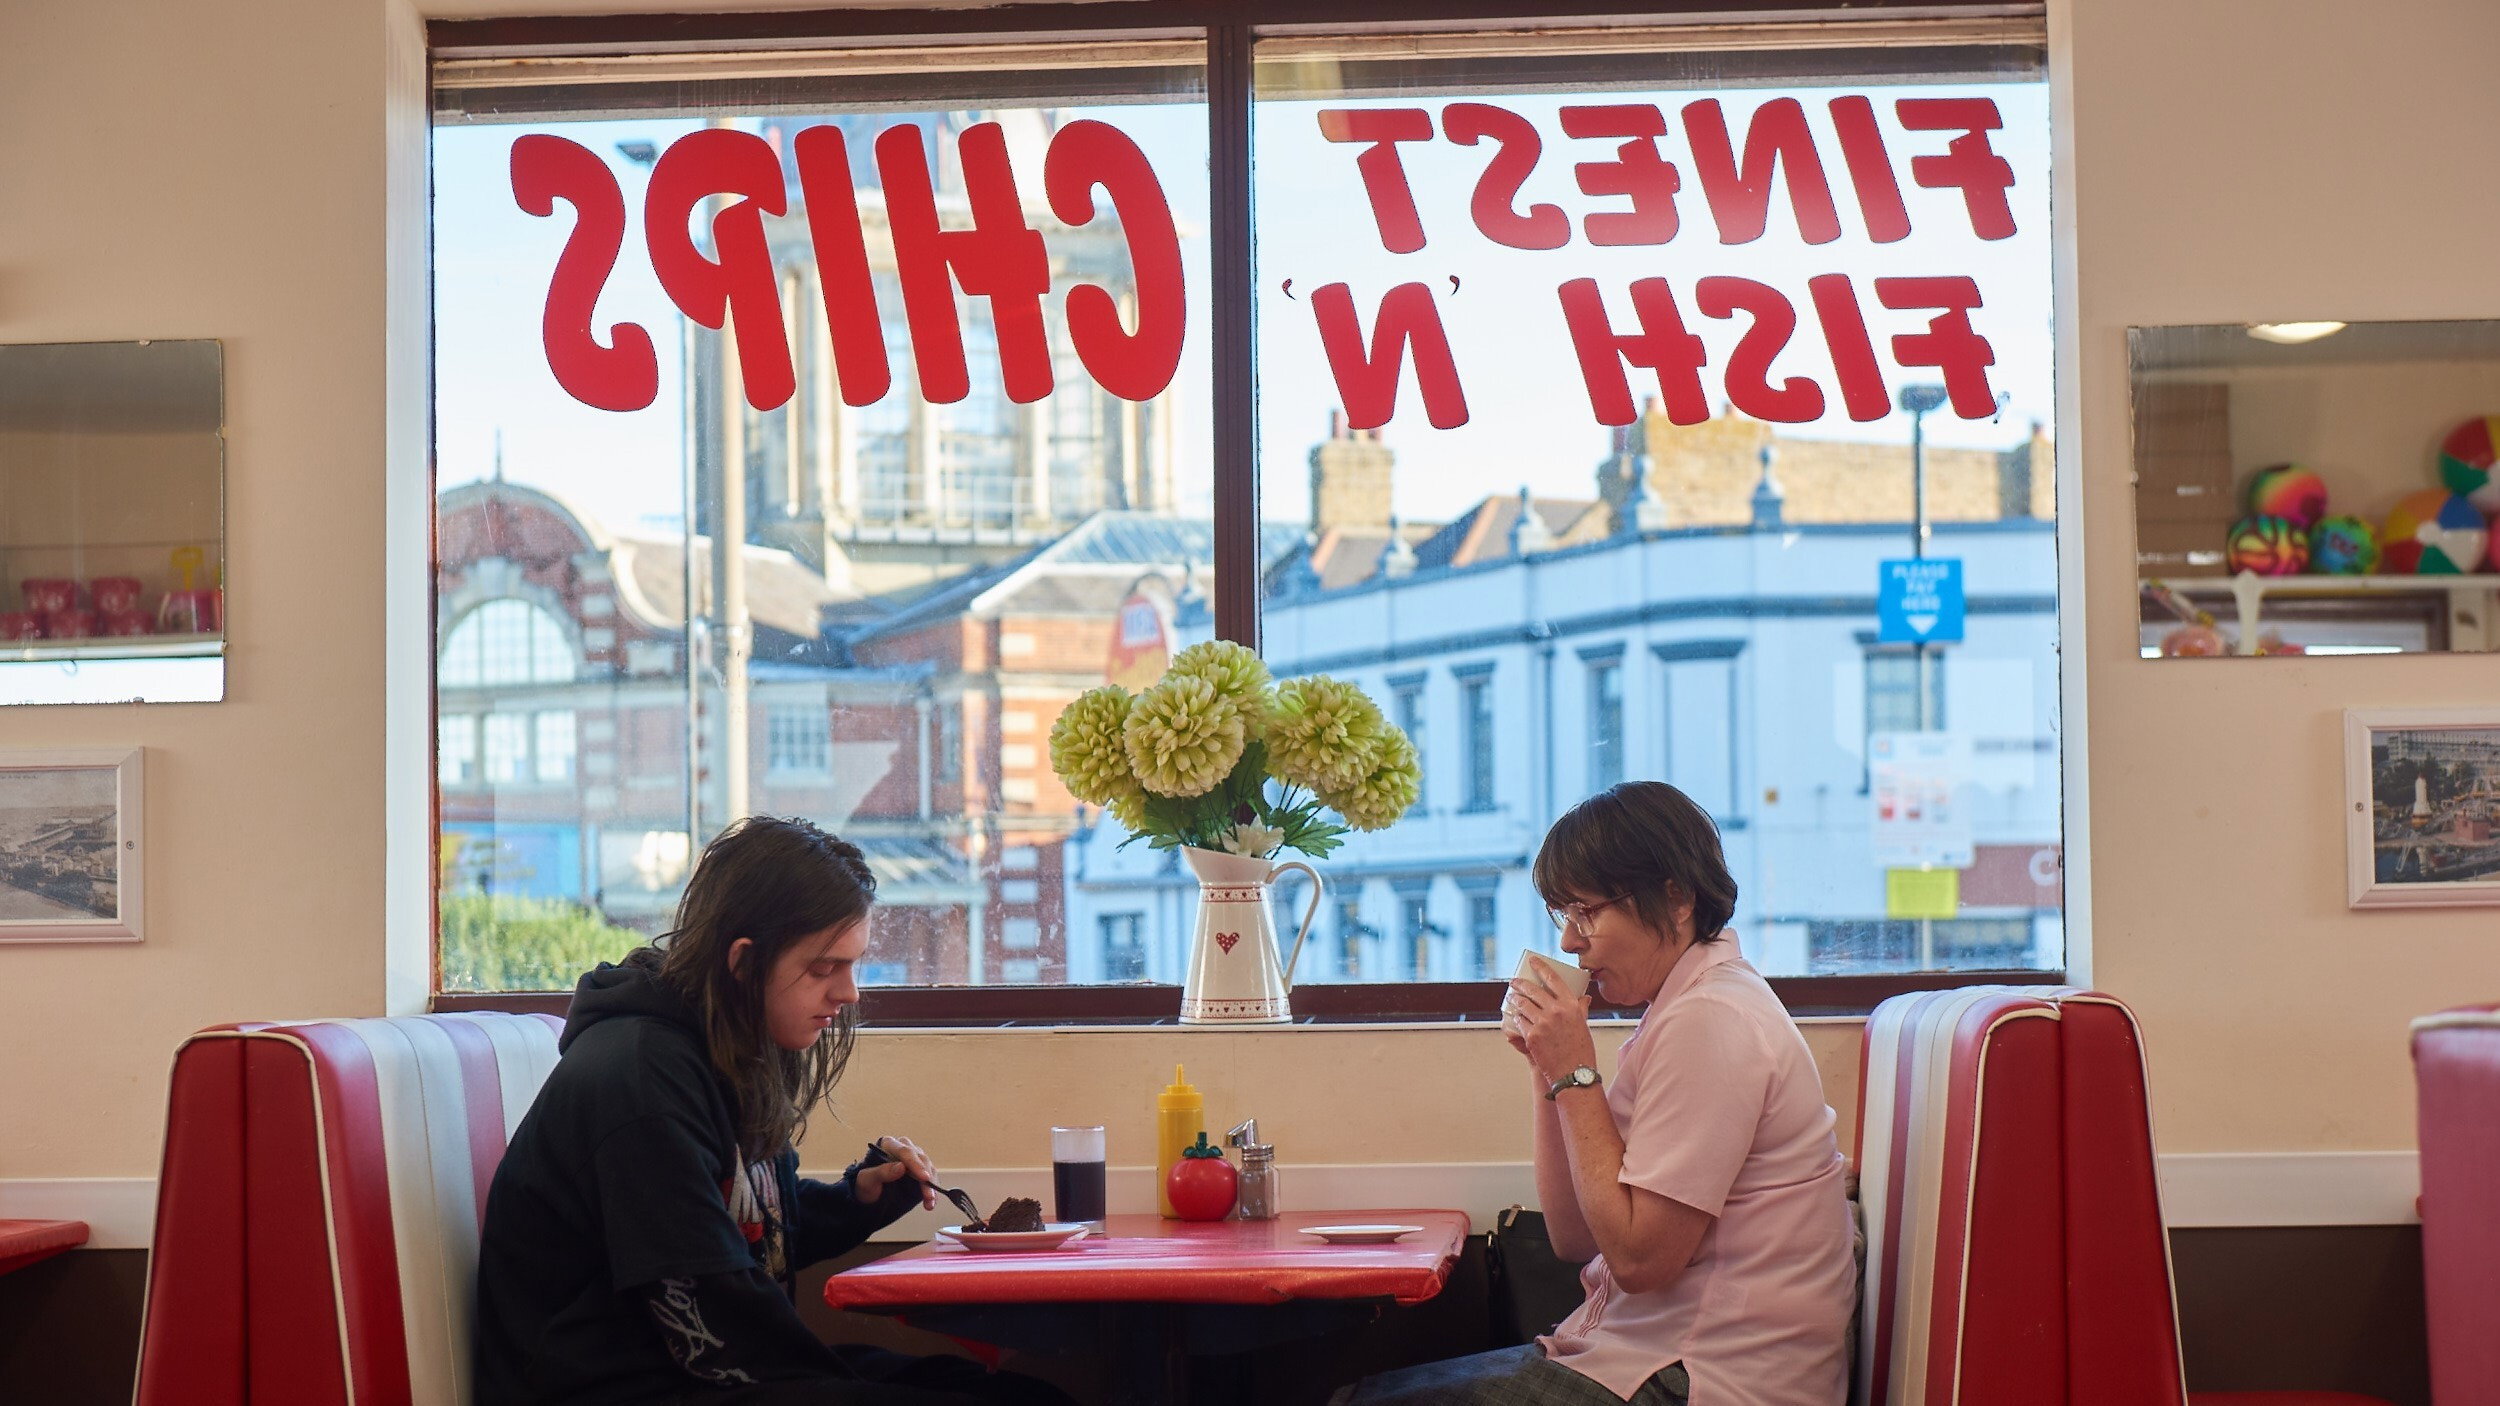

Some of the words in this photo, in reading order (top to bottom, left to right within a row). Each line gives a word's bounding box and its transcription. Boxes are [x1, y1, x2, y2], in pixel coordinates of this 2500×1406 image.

[1892, 564, 1949, 580] PLEASE
[1906, 580, 1936, 594] PAY
[1901, 596, 1942, 611] HERE
